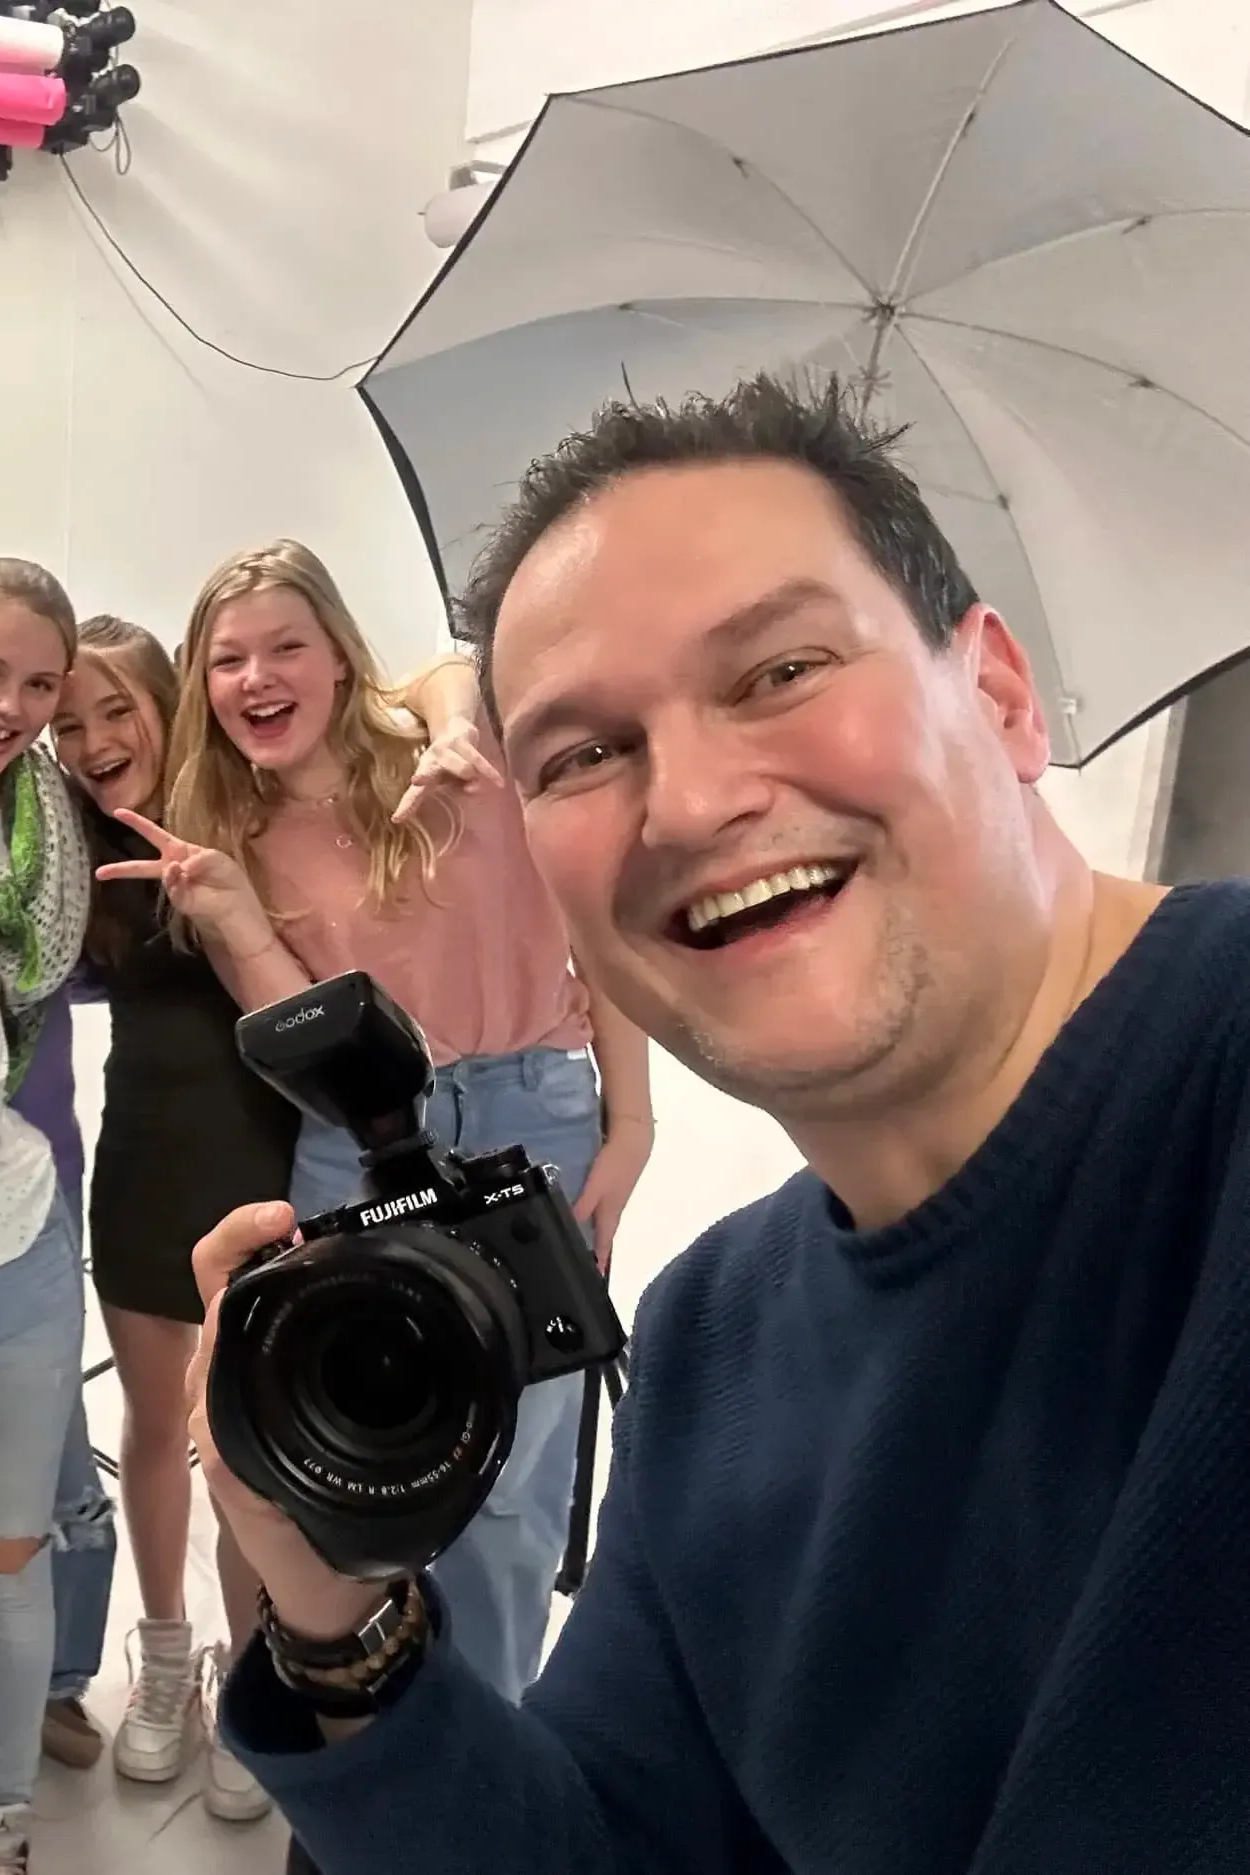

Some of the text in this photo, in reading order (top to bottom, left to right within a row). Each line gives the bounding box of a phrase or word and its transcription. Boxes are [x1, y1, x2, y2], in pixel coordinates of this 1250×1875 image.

[359, 1188, 438, 1227] FUJIFILM
[326, 1471, 342, 1487] WR
[347, 1480, 362, 1494] LM
